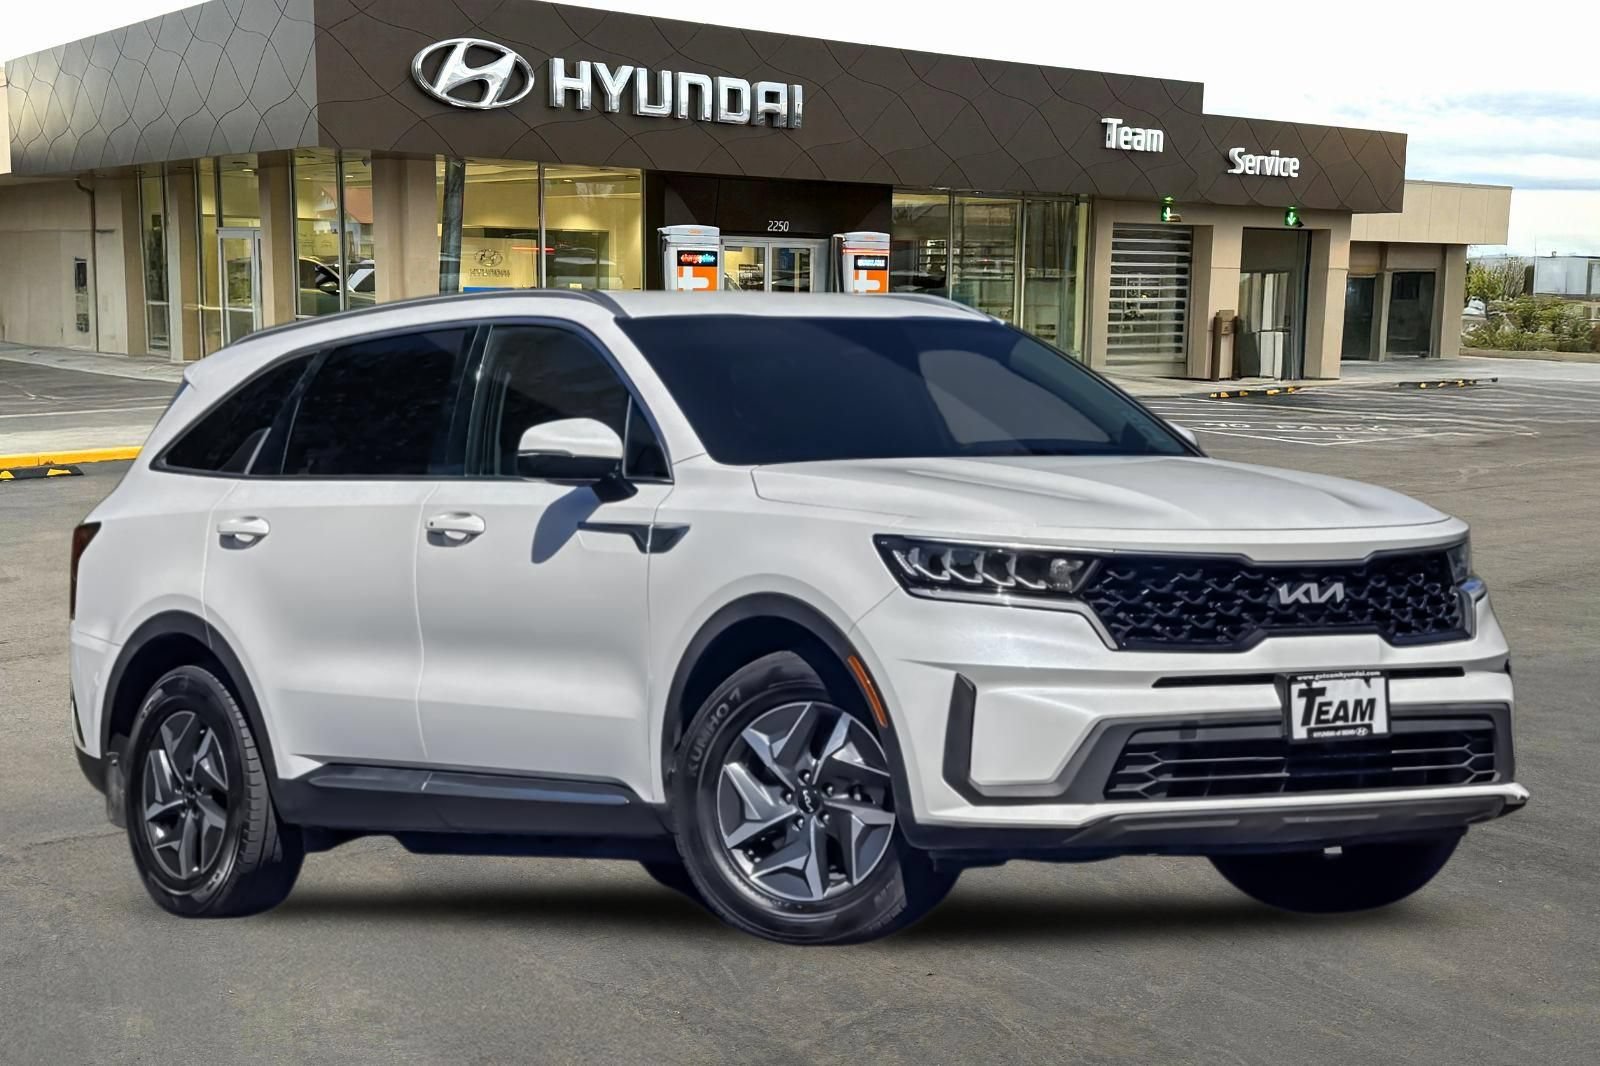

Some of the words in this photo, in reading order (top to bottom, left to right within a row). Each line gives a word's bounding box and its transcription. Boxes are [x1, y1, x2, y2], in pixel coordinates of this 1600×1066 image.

[548, 57, 803, 129] HYUNDAI
[1101, 118, 1164, 152] Team
[1227, 147, 1300, 178] Service
[767, 220, 790, 232] 2250
[1279, 582, 1345, 604] KIA
[1297, 687, 1376, 727] TEAM
